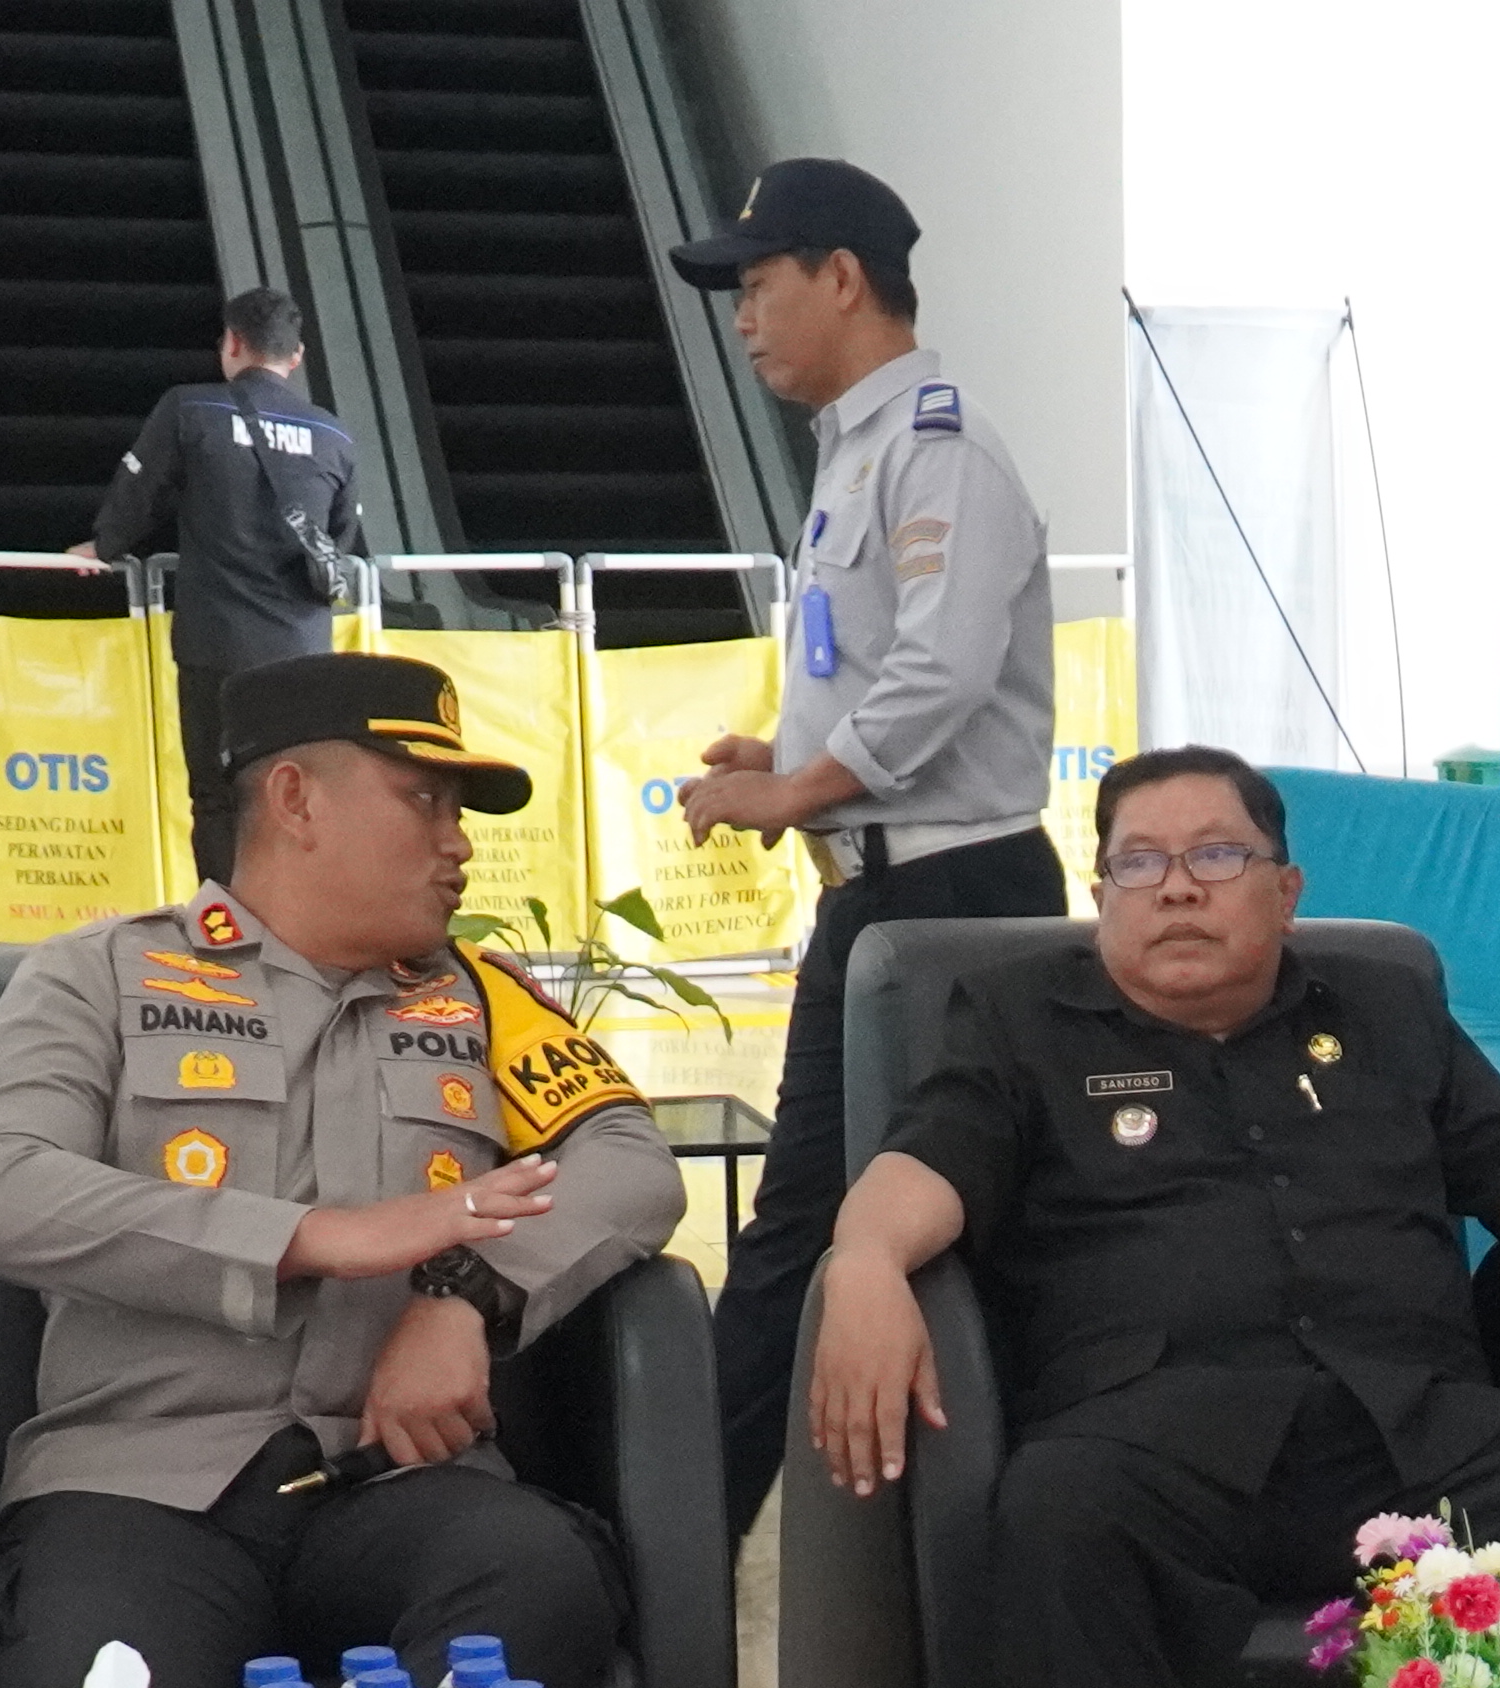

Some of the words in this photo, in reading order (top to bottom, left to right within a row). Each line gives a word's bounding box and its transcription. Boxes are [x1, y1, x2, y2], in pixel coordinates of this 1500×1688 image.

[5, 752, 111, 793] OTIS
[1053, 745, 1116, 781] TIS
[65, 817, 125, 835] DALAM
[8, 842, 107, 860] PERAWATAN
[15, 869, 111, 887] PERBAIKAN
[655, 860, 749, 882] PEKERJAAN
[651, 894, 693, 912] ORRY
[699, 891, 731, 909] FOR
[140, 1003, 268, 1040] DANANG
[544, 1074, 589, 1107] OMP
[1100, 1076, 1160, 1090] SANTOSO
